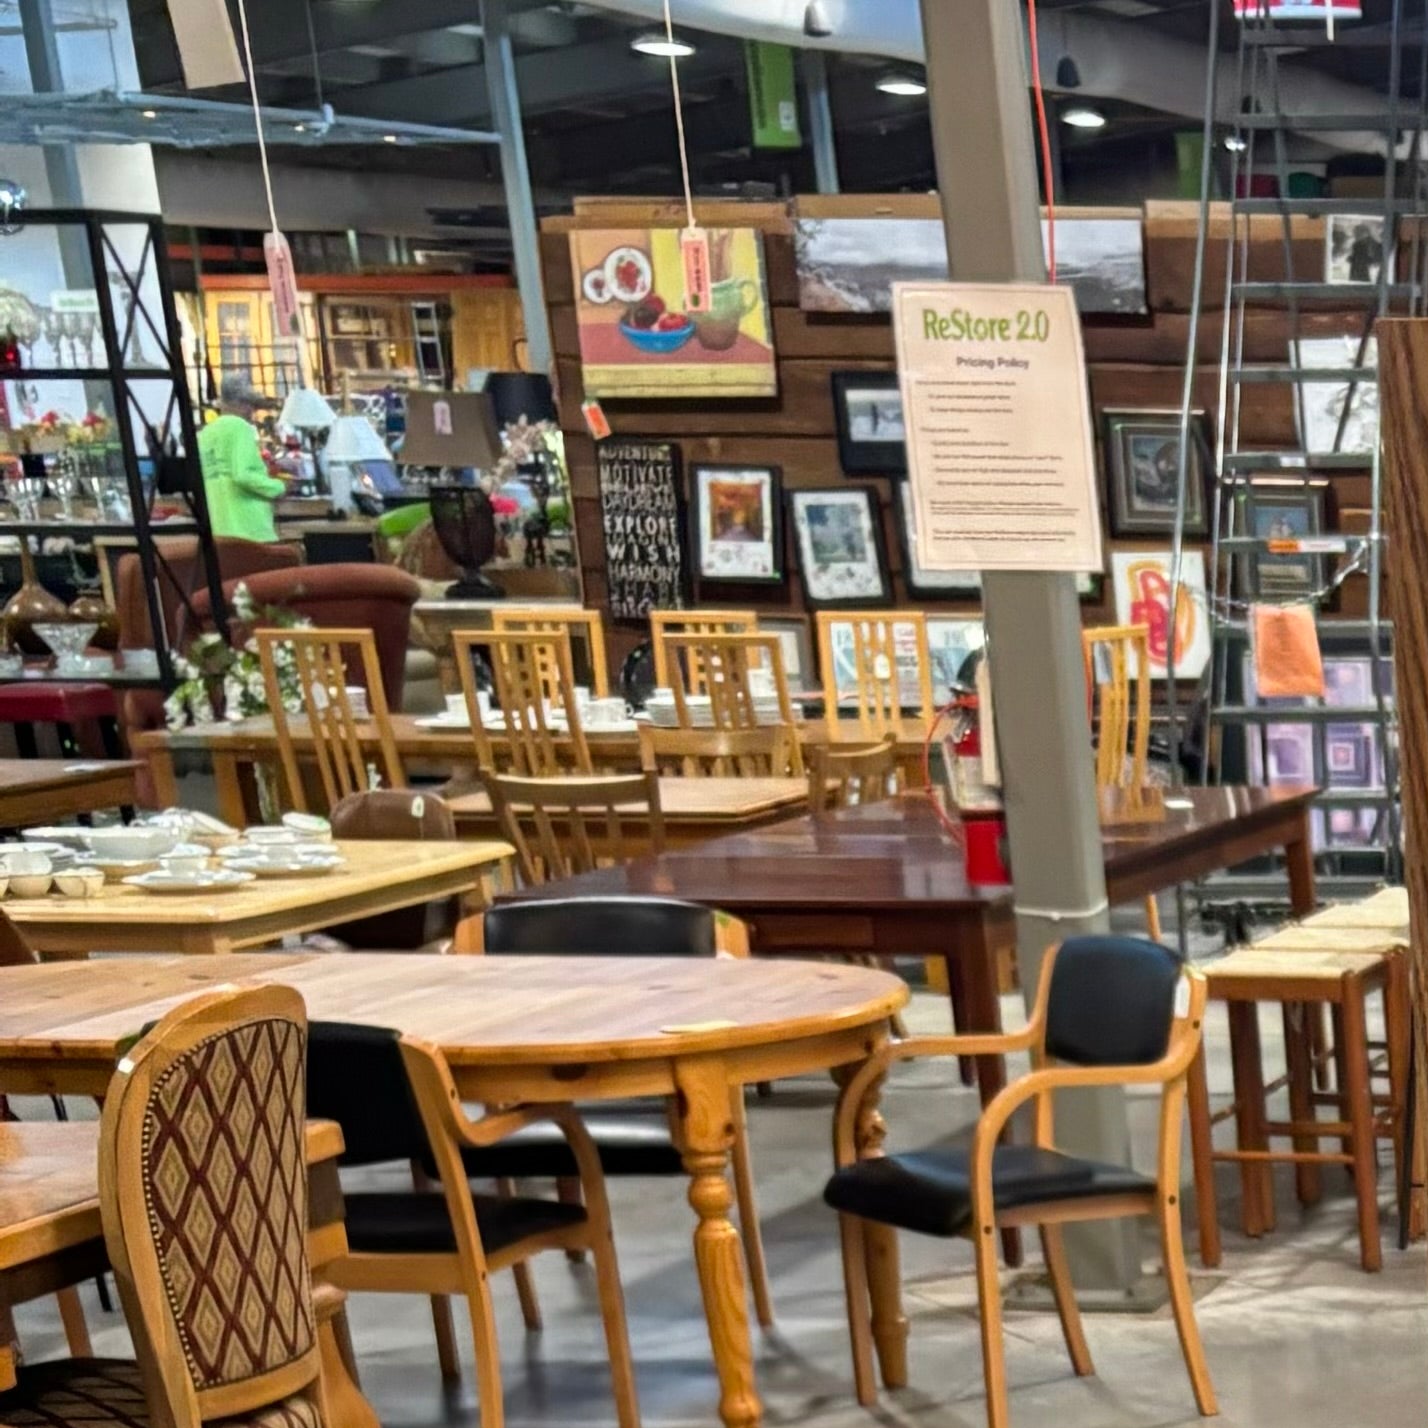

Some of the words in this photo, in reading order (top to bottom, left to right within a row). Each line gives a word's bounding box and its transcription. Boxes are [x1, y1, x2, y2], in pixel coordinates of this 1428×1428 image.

[922, 308, 1011, 341] ReStore
[1016, 309, 1049, 342] 2.0
[956, 356, 995, 369] Pricing
[997, 356, 1030, 369] Policy
[600, 464, 672, 483] MOTIVATE
[604, 514, 676, 534] EXPLORE
[606, 544, 680, 562] WISH
[608, 564, 680, 582] HARMONY
